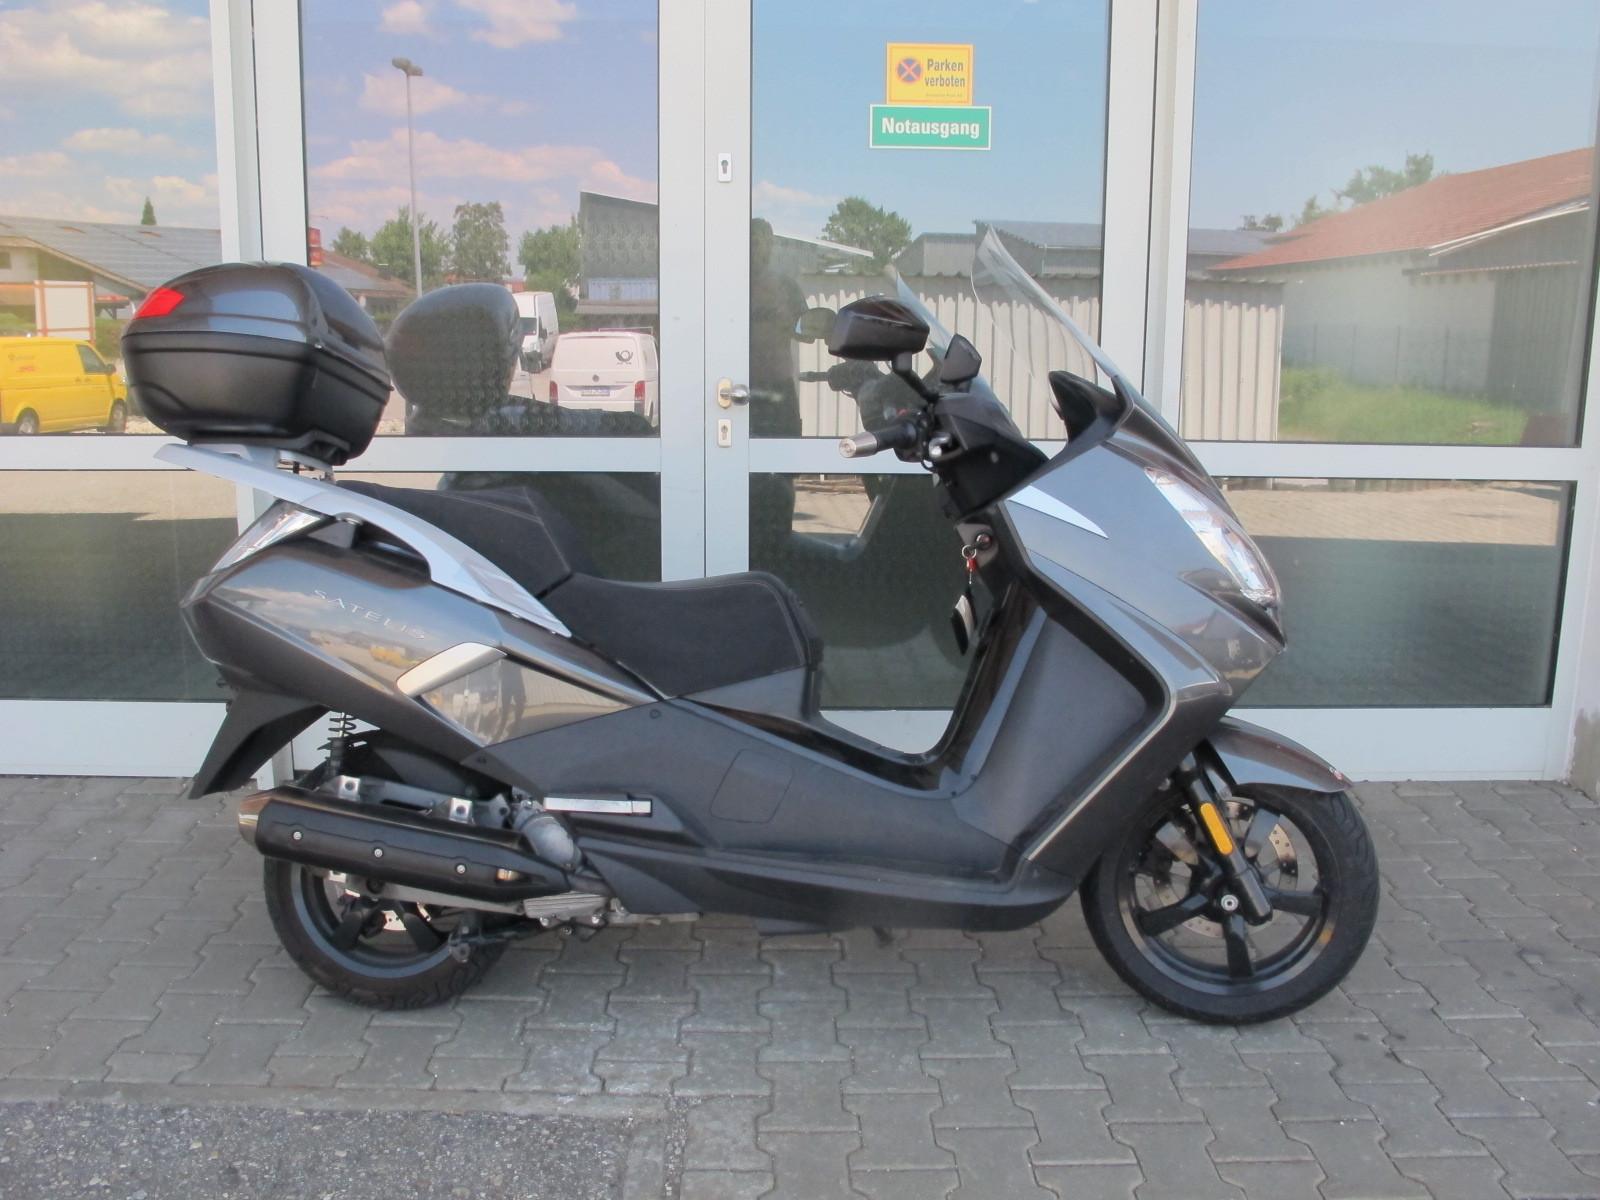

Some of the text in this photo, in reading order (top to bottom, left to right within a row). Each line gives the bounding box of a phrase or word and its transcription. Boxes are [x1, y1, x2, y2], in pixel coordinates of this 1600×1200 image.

[927, 58, 964, 72] Parken
[925, 75, 965, 87] verboten
[882, 117, 980, 139] Notausgang
